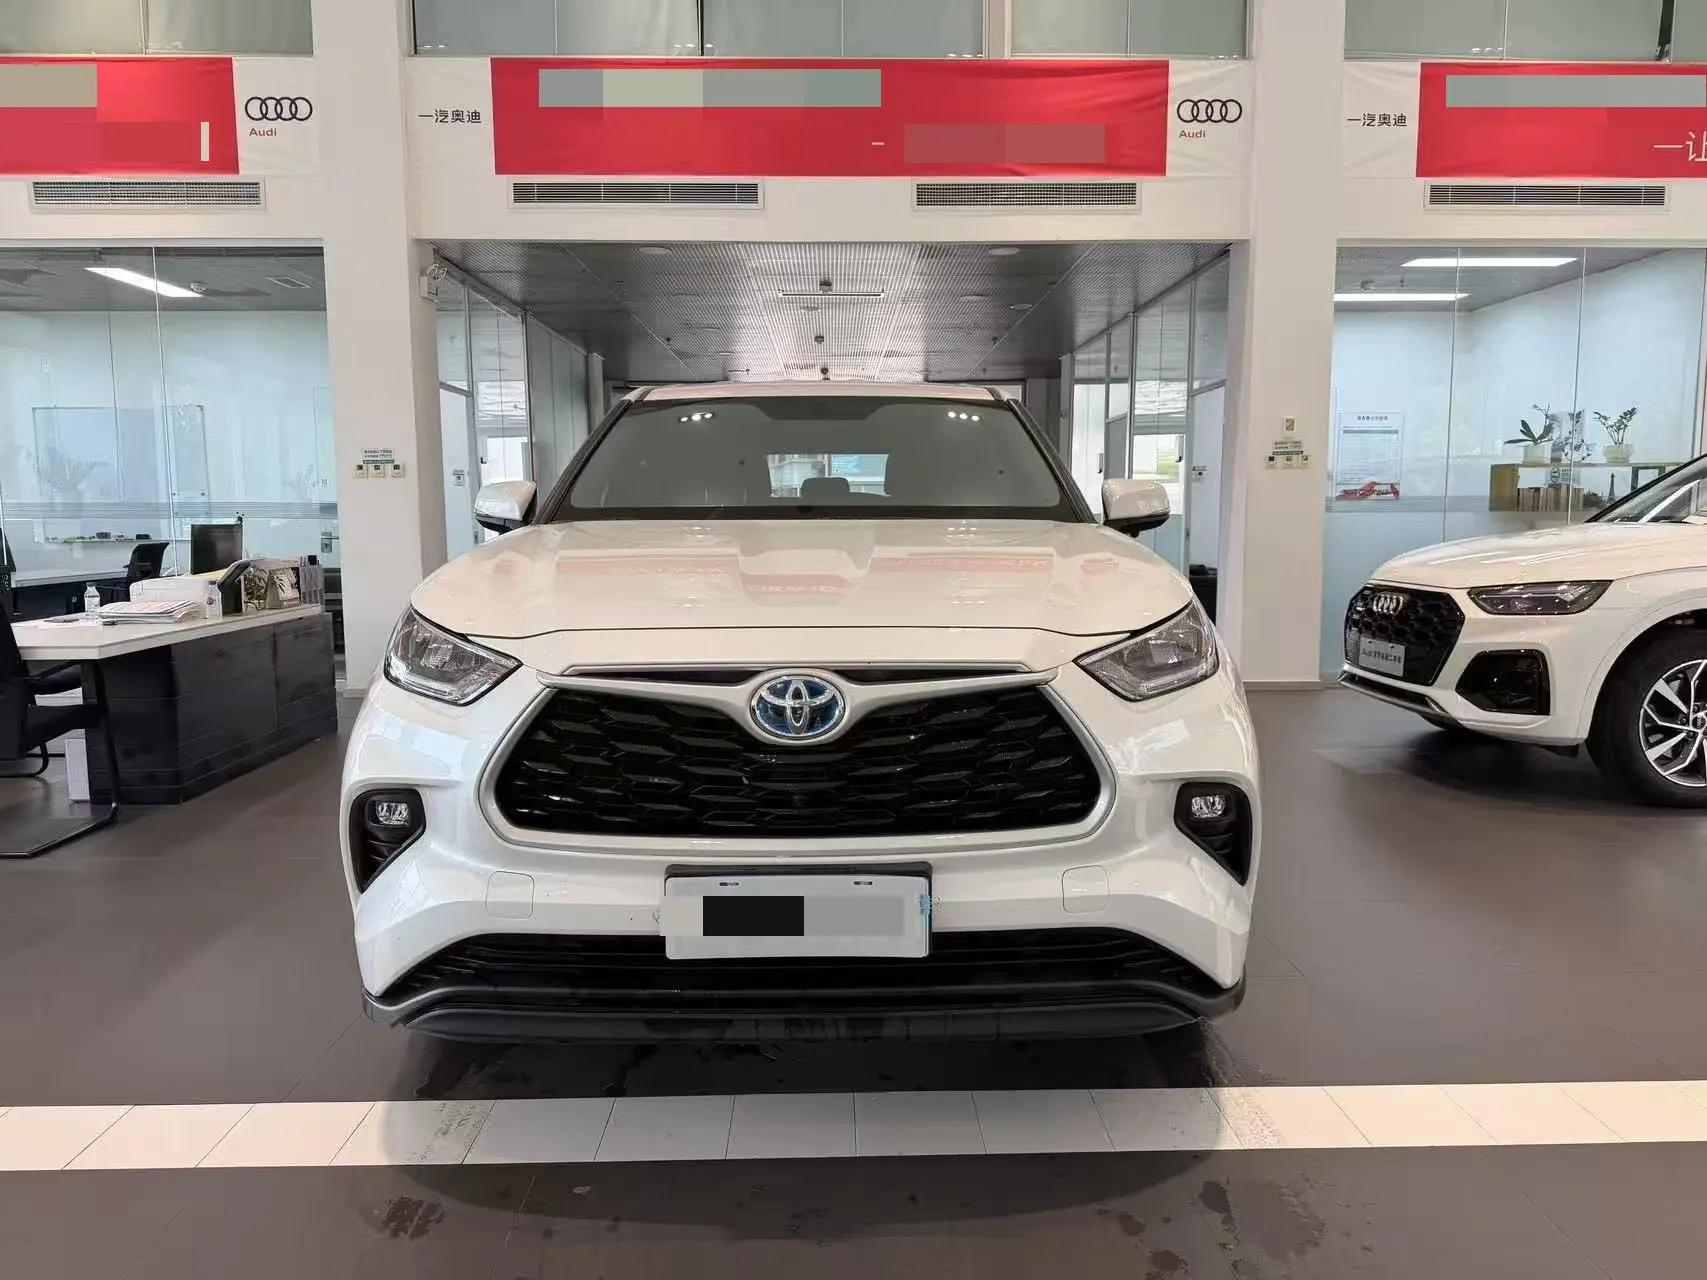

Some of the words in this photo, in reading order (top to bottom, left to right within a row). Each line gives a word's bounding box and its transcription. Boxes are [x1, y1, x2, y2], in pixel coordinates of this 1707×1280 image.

[418, 109, 482, 123] 一汽奥迪
[1346, 112, 1408, 127] 一汽奥迪
[249, 127, 278, 137] Audi
[1179, 129, 1206, 139] Audi
